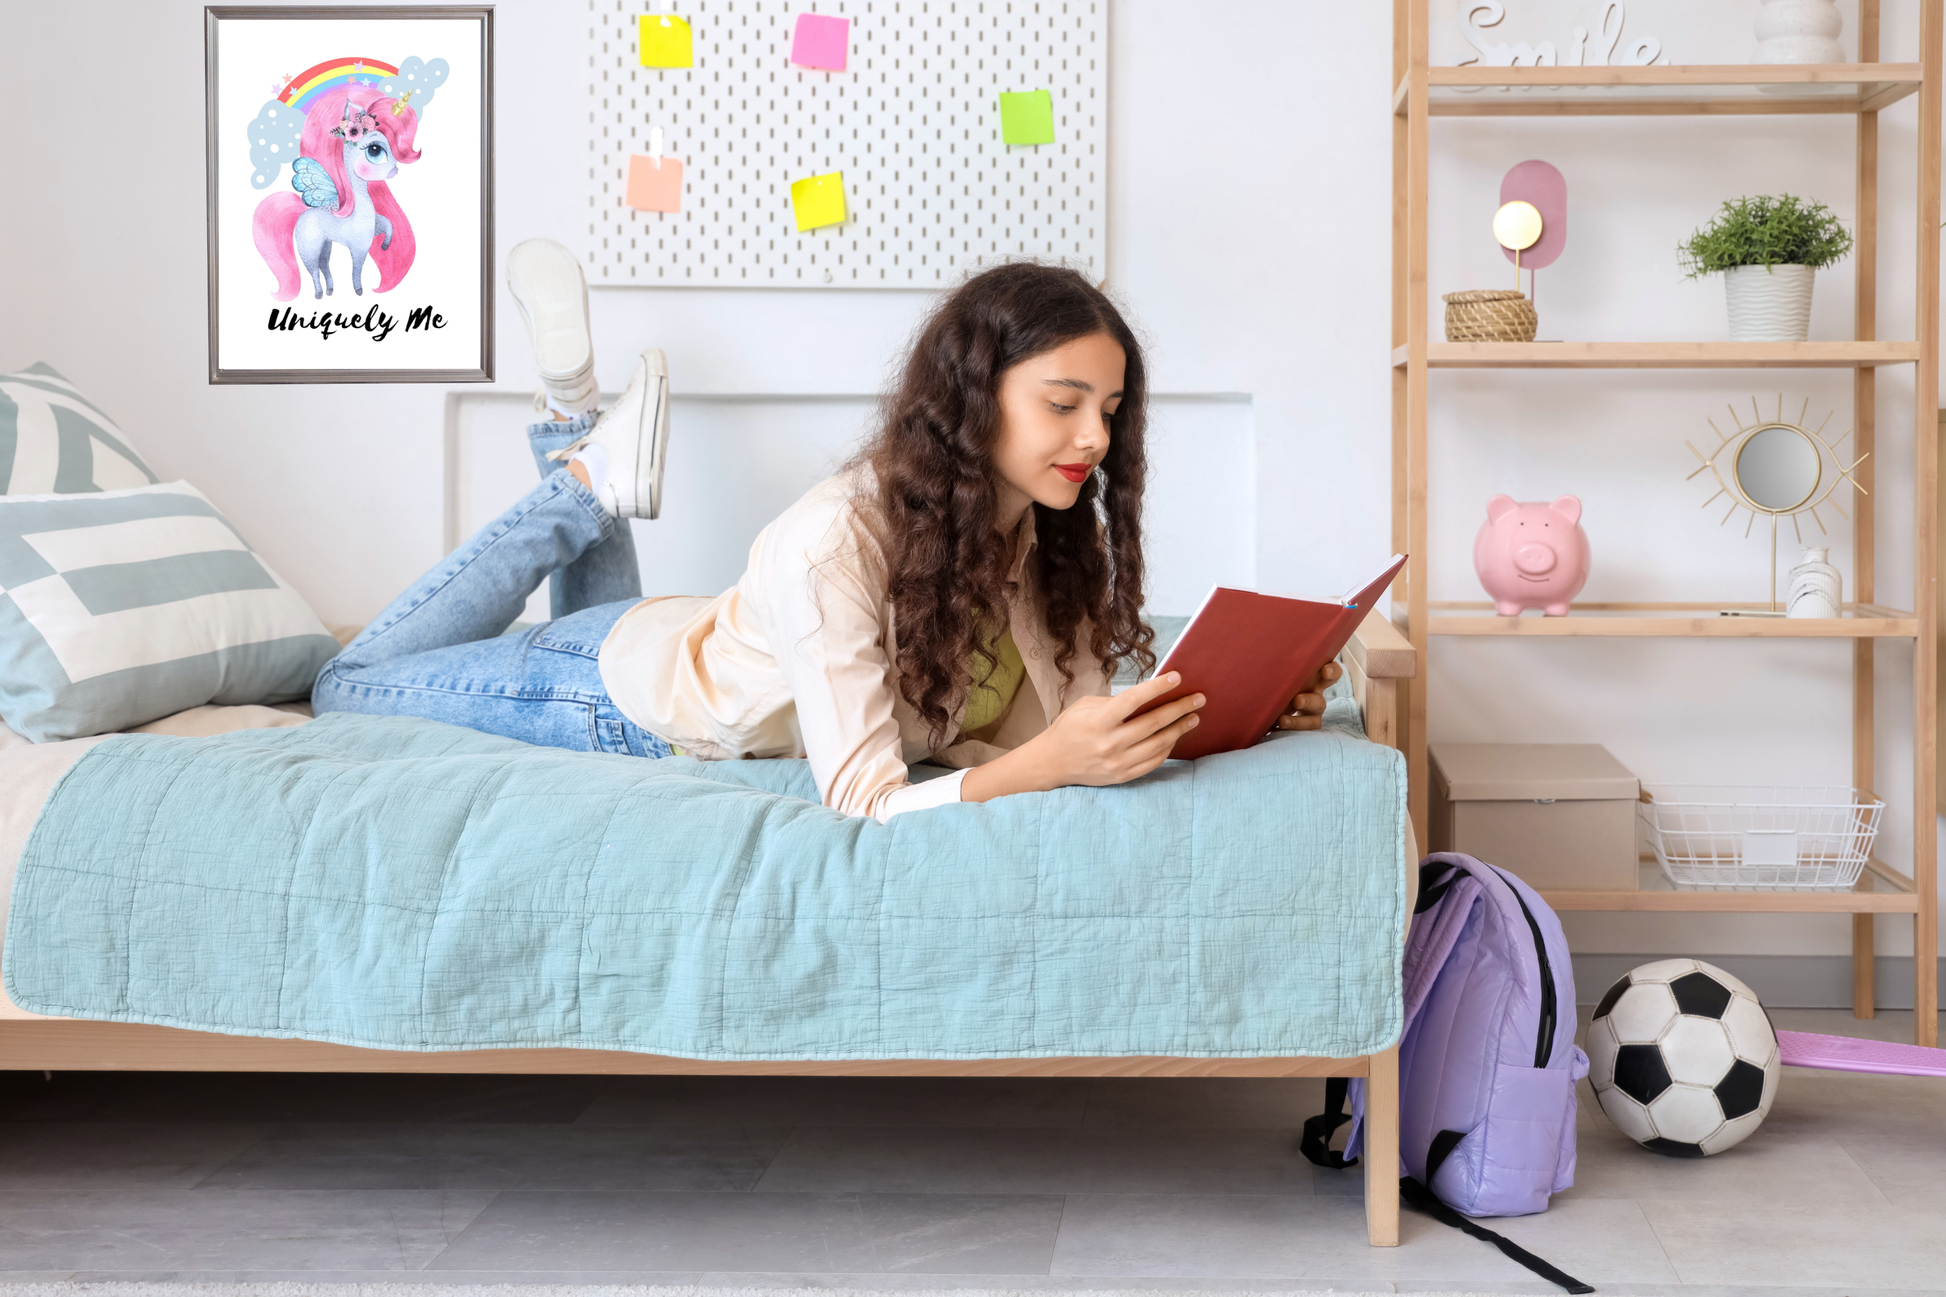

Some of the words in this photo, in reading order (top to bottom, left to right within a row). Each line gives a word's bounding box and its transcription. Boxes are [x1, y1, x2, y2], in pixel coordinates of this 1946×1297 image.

[1448, 0, 1671, 67] Smile
[268, 304, 399, 342] Uniquely
[404, 305, 449, 333] Me
